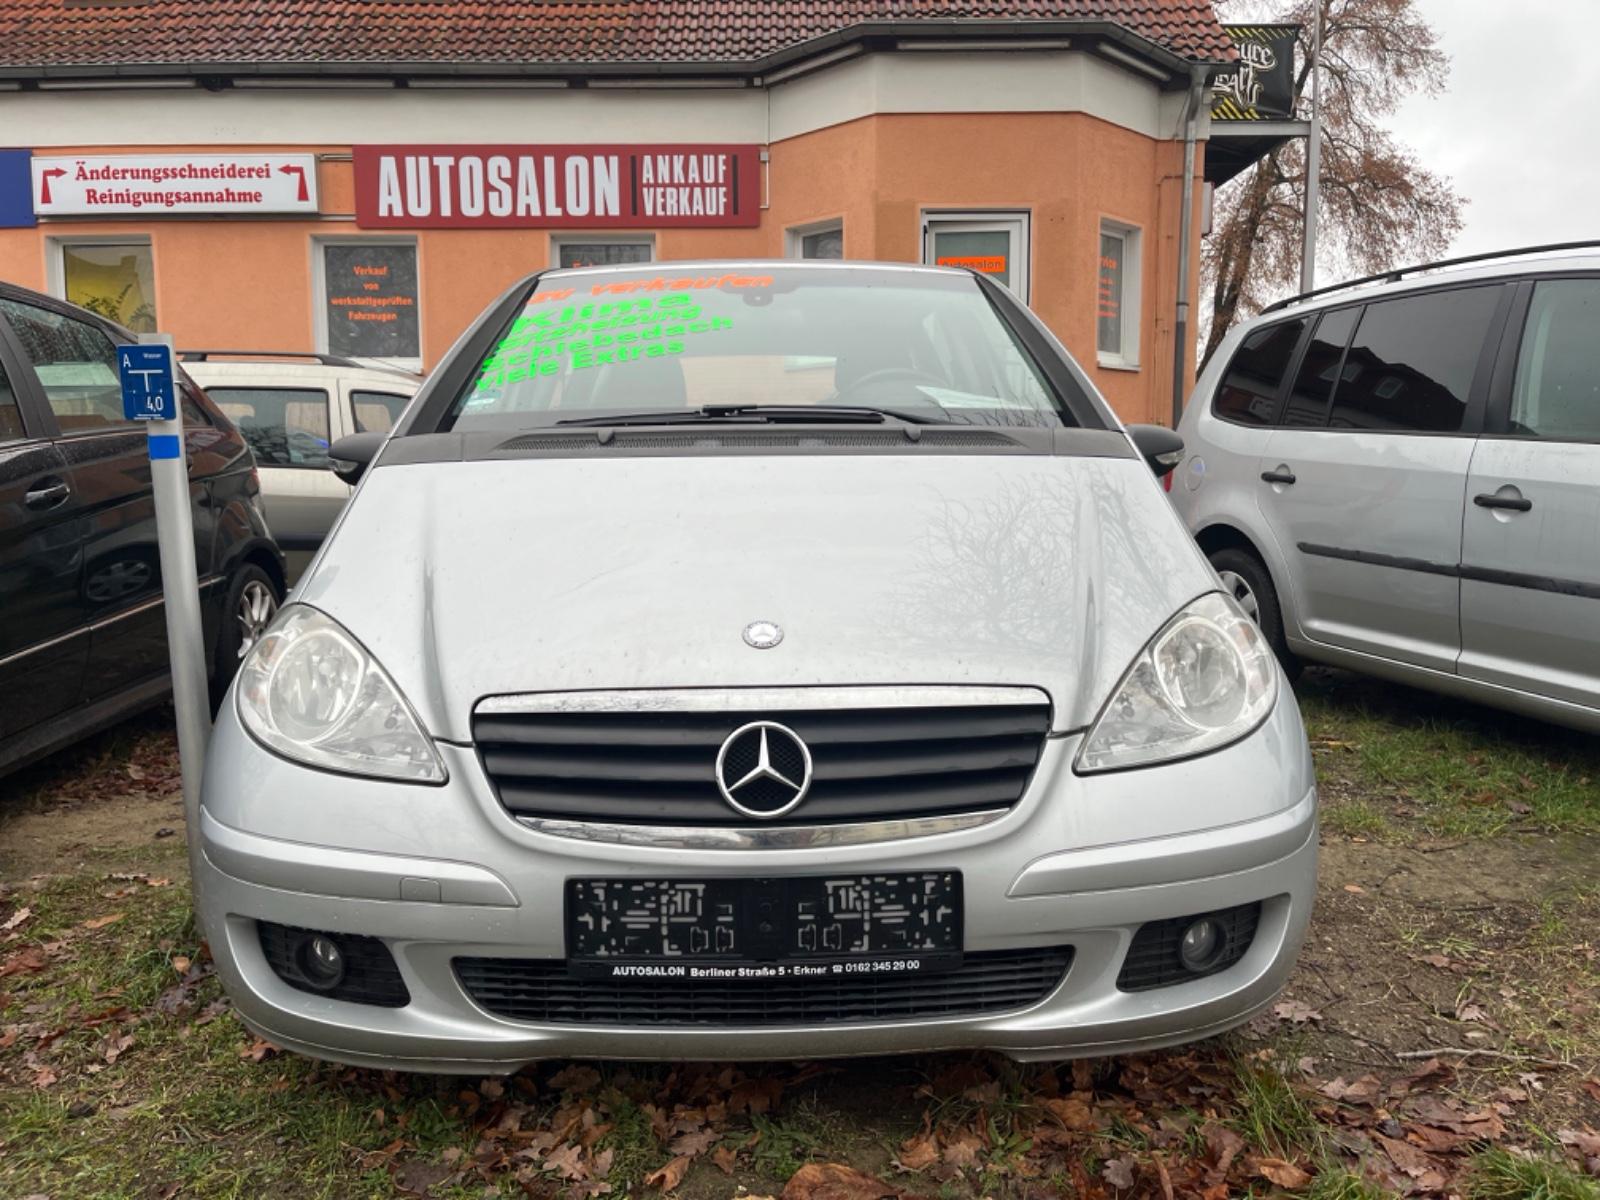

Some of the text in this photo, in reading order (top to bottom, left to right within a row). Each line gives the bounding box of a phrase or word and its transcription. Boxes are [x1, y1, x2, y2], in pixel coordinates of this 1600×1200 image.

[75, 160, 272, 183] Änderungsschneiderei
[642, 154, 727, 184] ANKAUF
[378, 155, 620, 217] AUTOSALON
[85, 188, 263, 208] Reinigungsannahme
[642, 186, 728, 217] VERKAUF
[353, 265, 388, 276] Verkauf
[363, 282, 380, 291] von
[347, 311, 398, 322] Fahrzeugen
[122, 352, 132, 369] A
[571, 339, 686, 370] Extras
[612, 966, 686, 976] AUTOSALON
[690, 967, 736, 977] Berliner
[738, 966, 777, 977] Straße
[778, 966, 786, 976] 5
[793, 966, 828, 976] Erkner
[872, 961, 892, 972] 345
[893, 960, 905, 971] 29
[906, 959, 920, 970] 00
